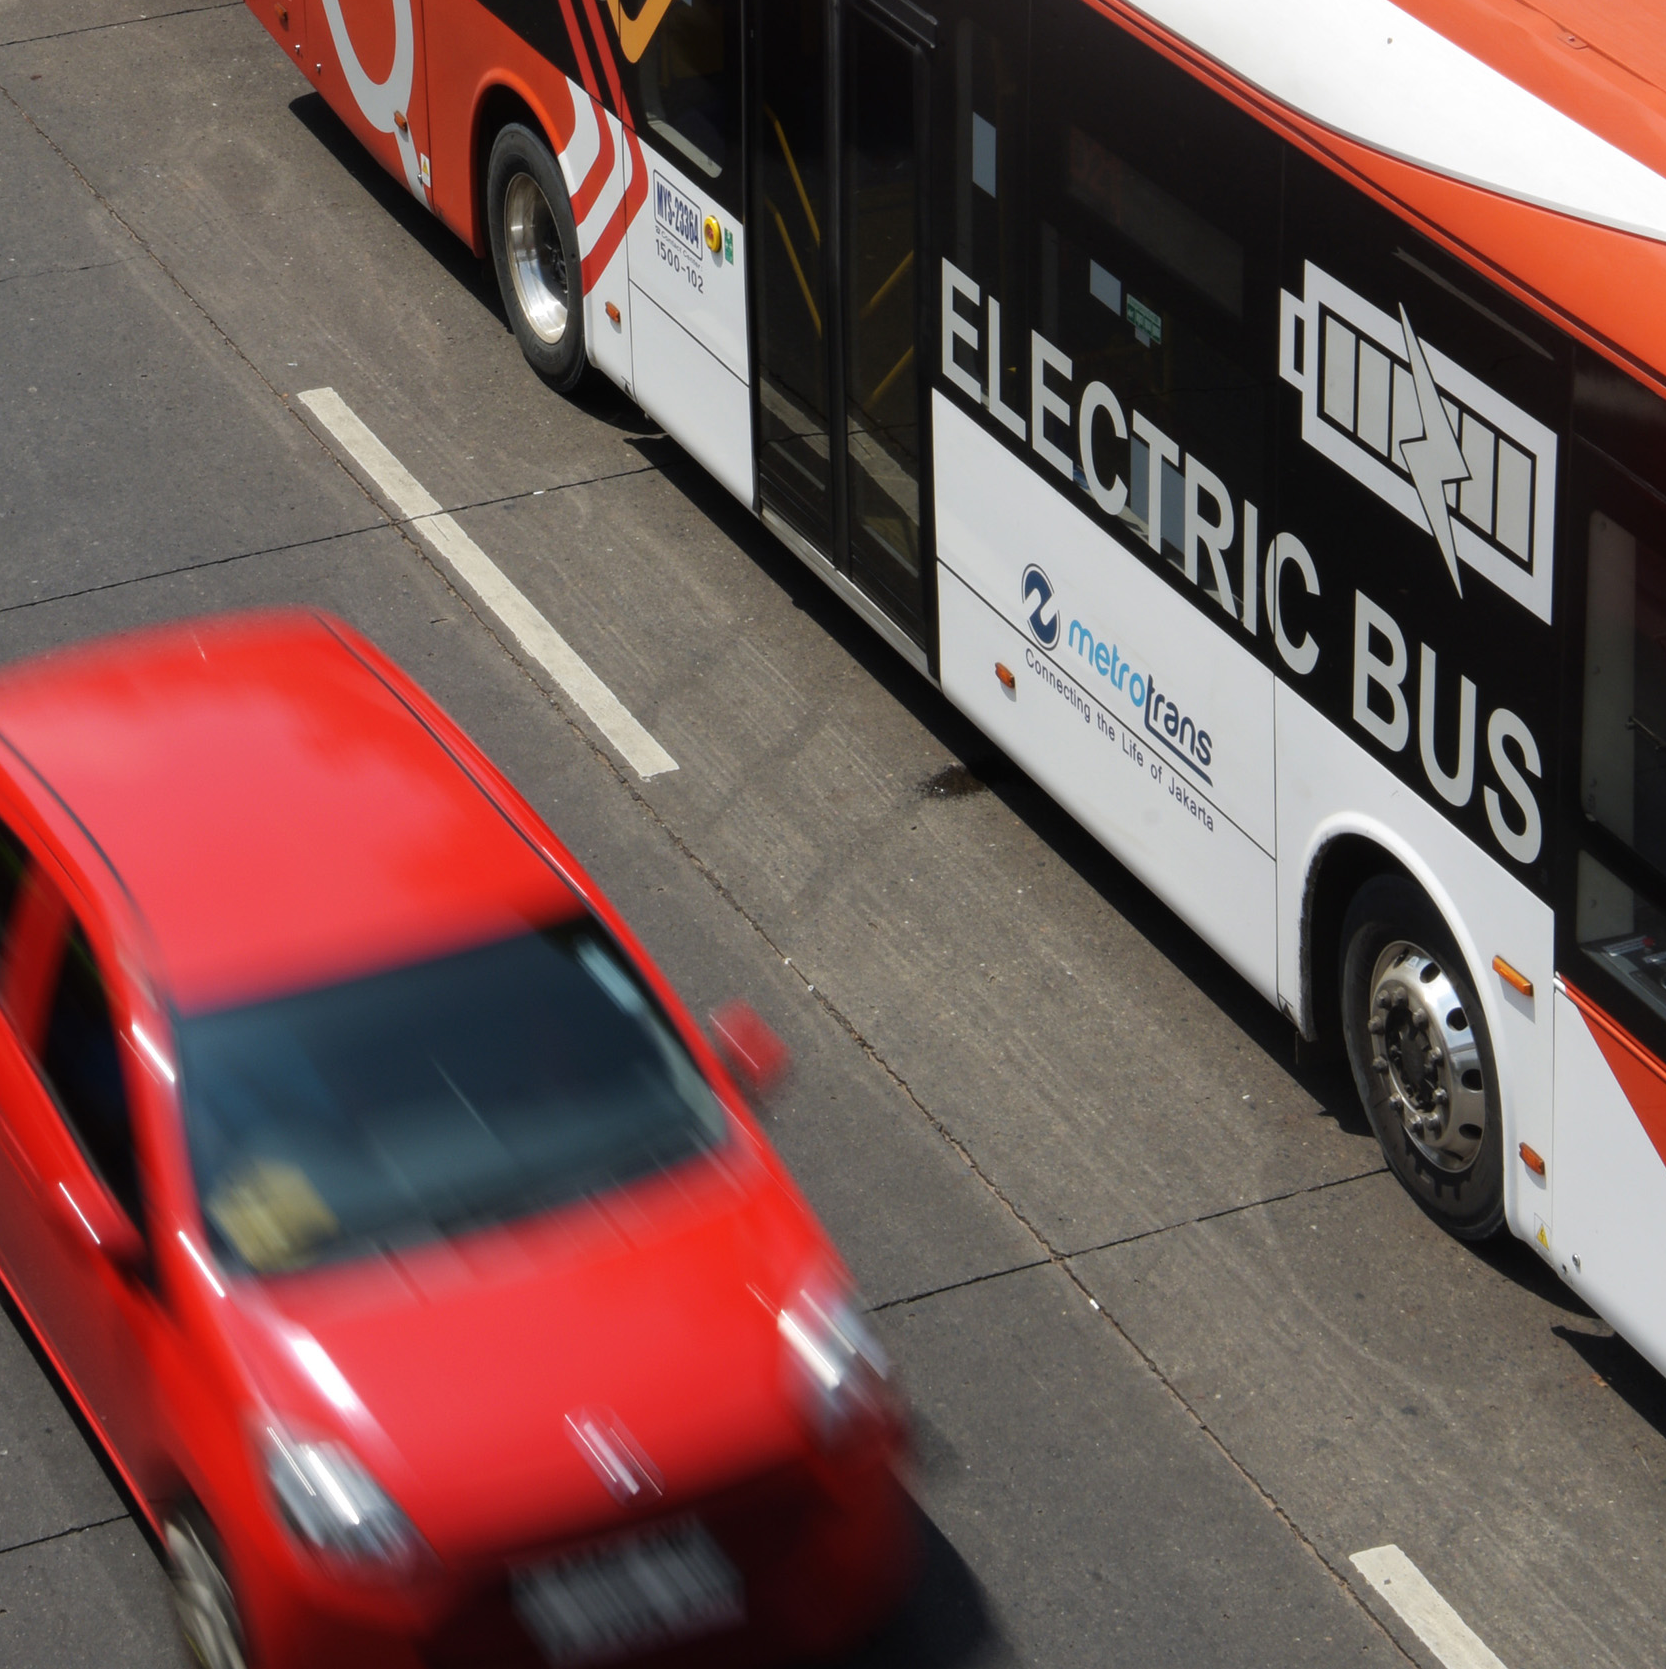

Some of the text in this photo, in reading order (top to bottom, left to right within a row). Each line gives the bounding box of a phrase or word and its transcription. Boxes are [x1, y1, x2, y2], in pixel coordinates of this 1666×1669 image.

[655, 239, 704, 294] 1500-102
[656, 180, 700, 250] MYS-23364
[941, 256, 1543, 864] ELECTRIC BUS
[1025, 647, 1214, 833] Connecting the Life of Jakarta
[1068, 619, 1214, 787] metrotrans
